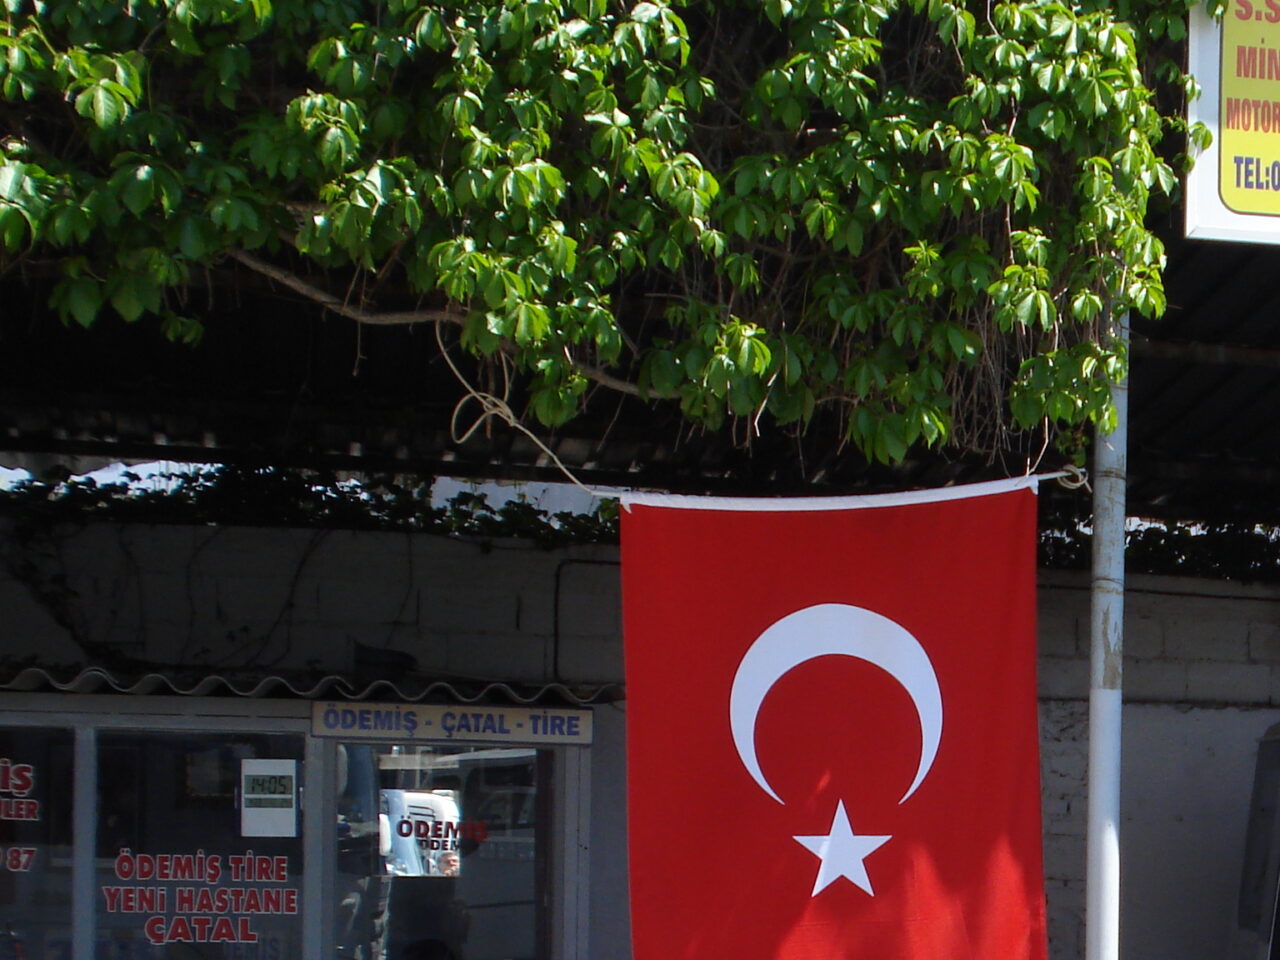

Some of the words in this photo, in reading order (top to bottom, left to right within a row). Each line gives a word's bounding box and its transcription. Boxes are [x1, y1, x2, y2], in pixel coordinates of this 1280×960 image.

[323, 704, 418, 738] ÖDEMİŞ
[441, 710, 511, 738] ÇATAL
[529, 711, 580, 736] TİRE
[115, 847, 222, 884] ÖDEMİŞ
[229, 849, 289, 882] TİRE
[176, 887, 299, 915] HASTANE
[144, 915, 258, 945] ÇATAL
